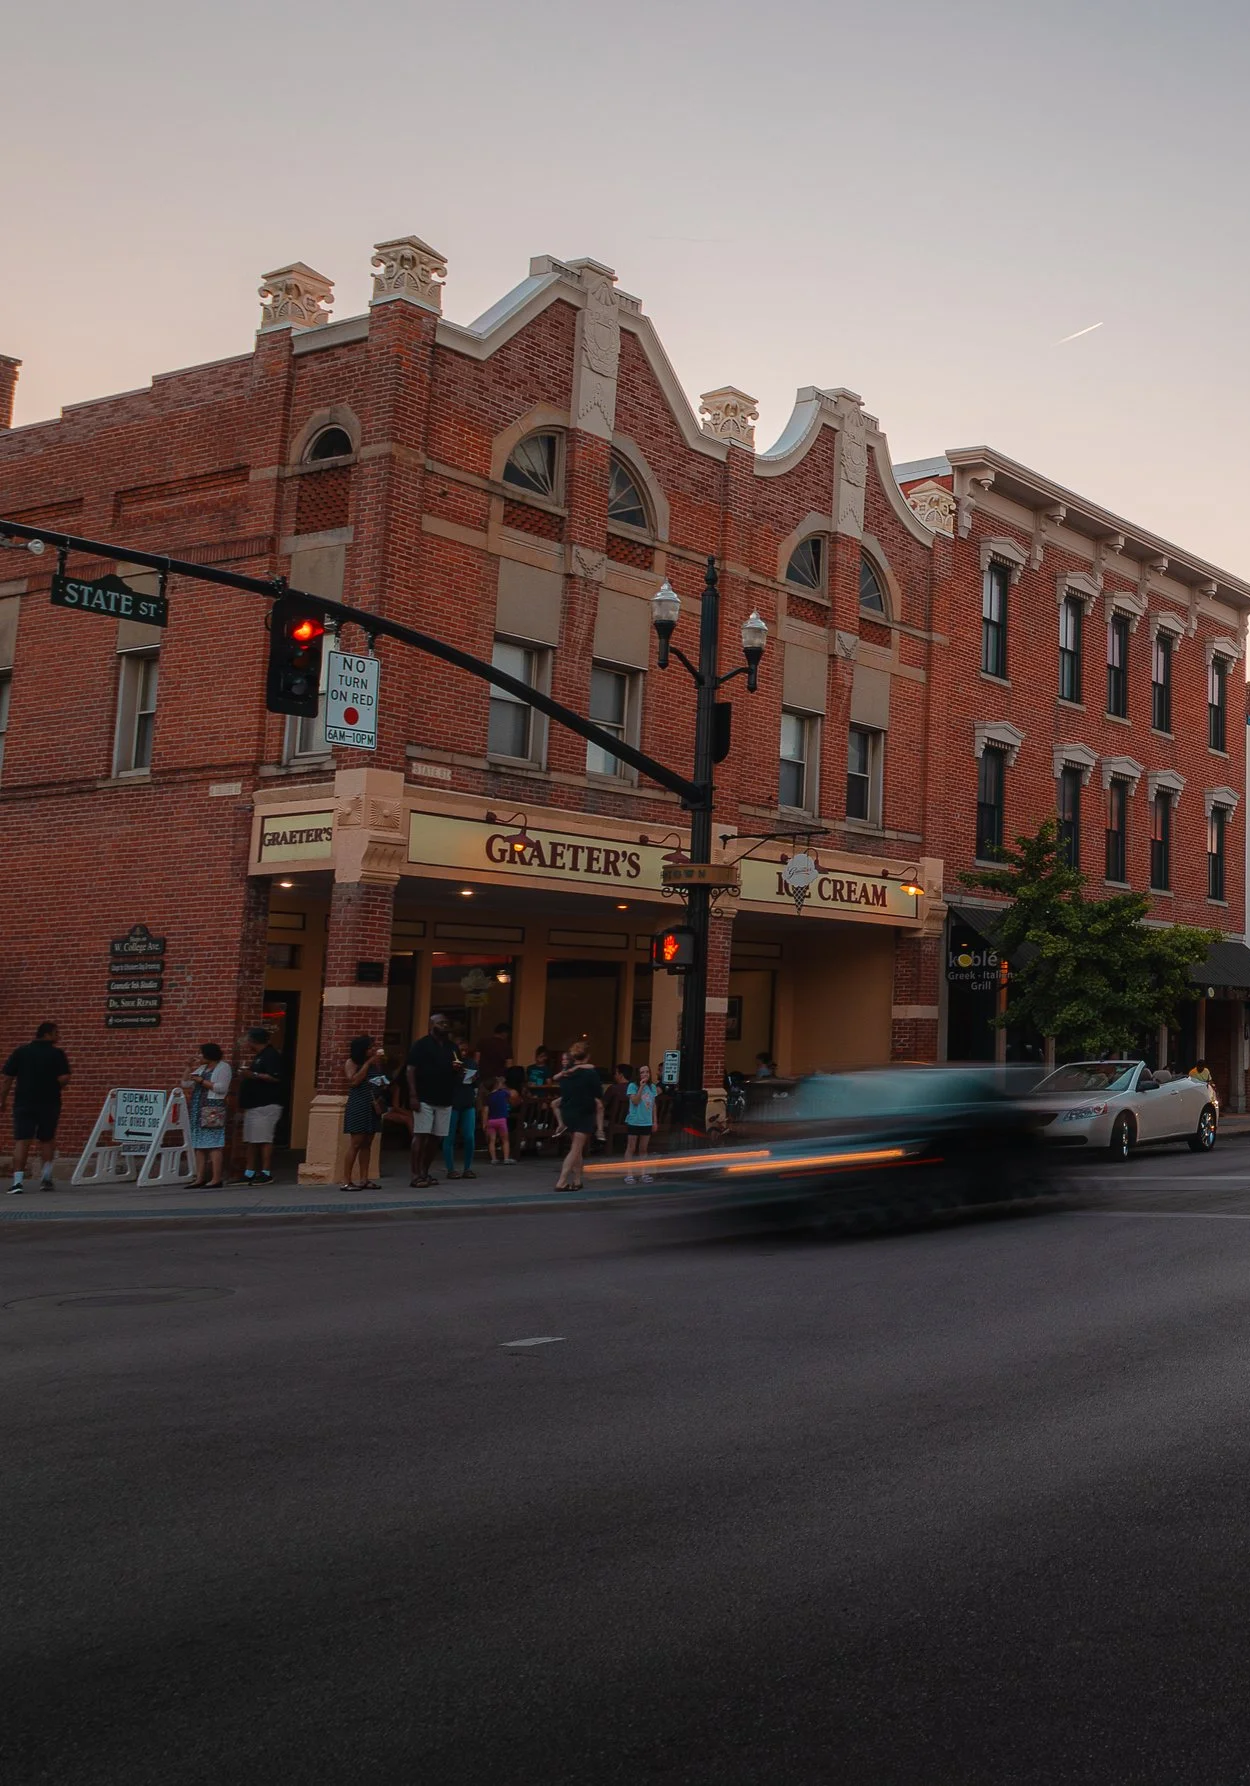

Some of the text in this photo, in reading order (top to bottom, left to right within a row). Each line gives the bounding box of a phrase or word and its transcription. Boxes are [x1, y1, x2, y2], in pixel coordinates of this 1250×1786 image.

[64, 583, 157, 617] STATE ST
[342, 657, 366, 673] NO
[338, 674, 368, 690] TURN
[331, 689, 374, 706] ON RED
[414, 765, 438, 777] STATE
[263, 826, 333, 847] GRAETER'S
[818, 877, 887, 907] CREAM
[948, 971, 976, 980] Greek
[971, 981, 991, 990] Grill
[122, 1093, 159, 1104] SIDEWALK
[125, 1105, 154, 1115] CLOSED
